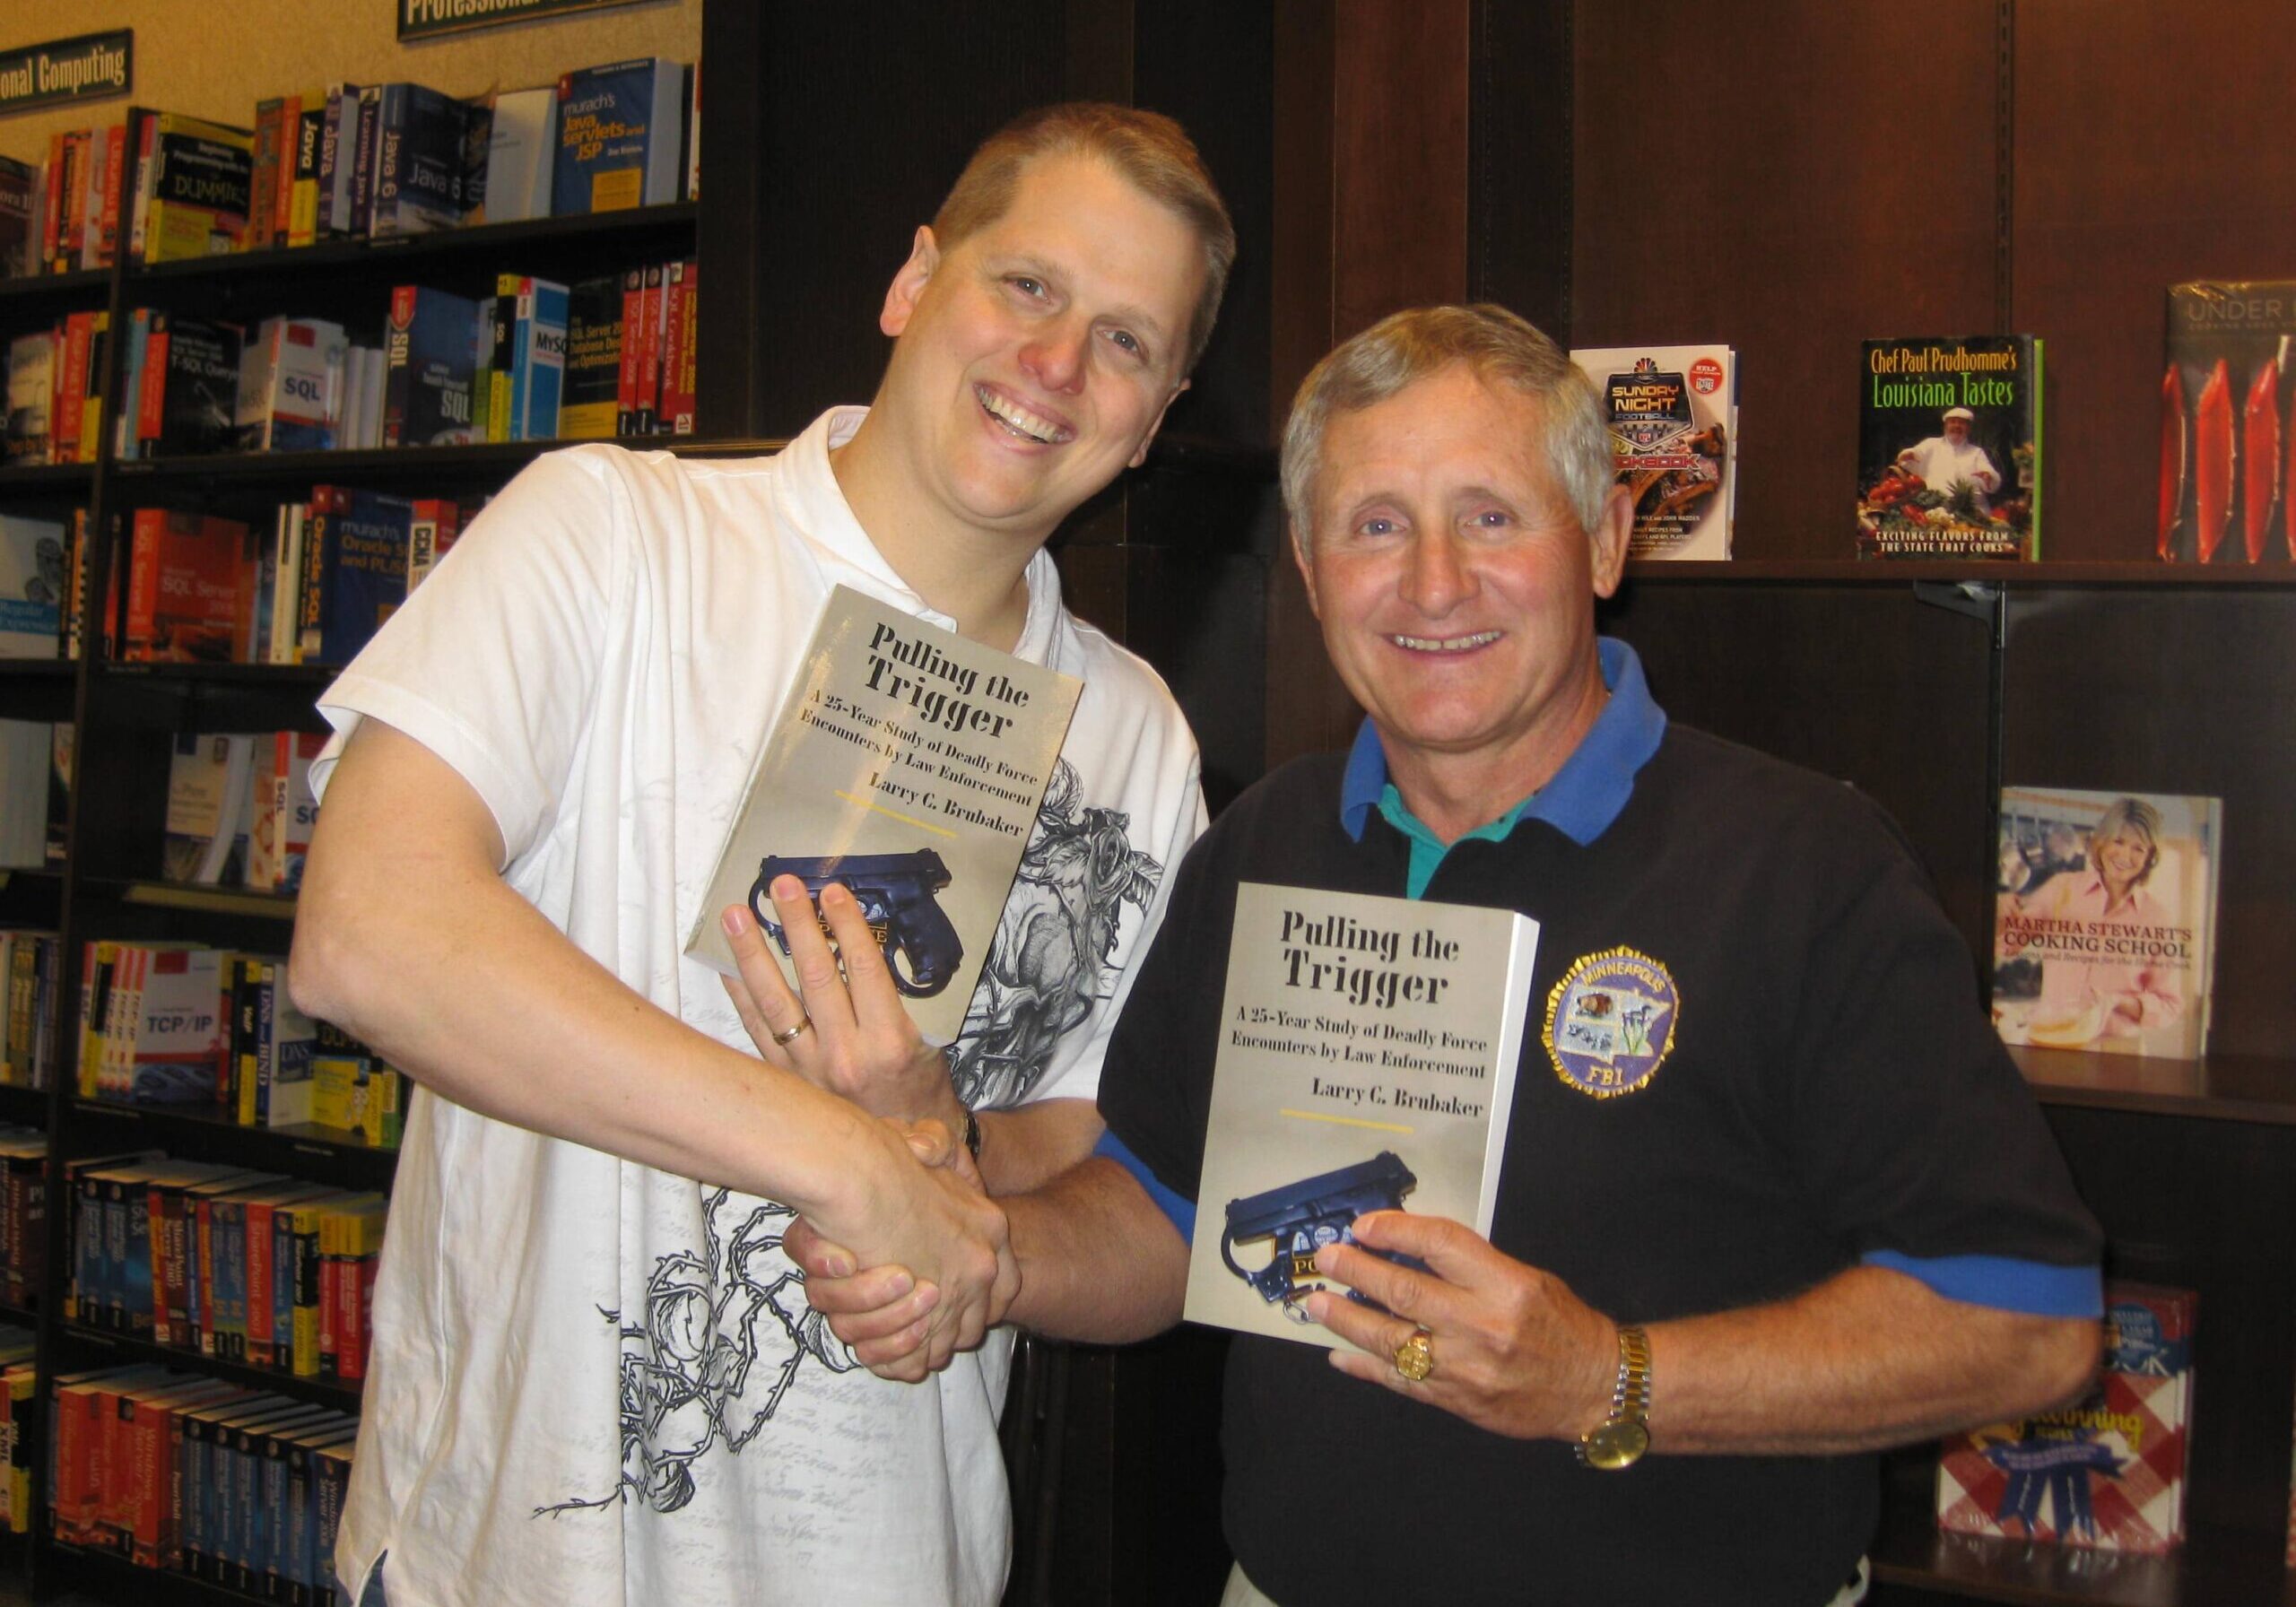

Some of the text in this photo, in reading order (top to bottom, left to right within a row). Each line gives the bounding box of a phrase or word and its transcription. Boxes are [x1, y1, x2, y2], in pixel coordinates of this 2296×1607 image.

[39, 47, 126, 93] Computing
[563, 92, 617, 115] murach's
[357, 109, 374, 176] Learning
[566, 115, 597, 133] Java
[301, 119, 317, 169] Java
[320, 126, 339, 178] Java
[576, 141, 604, 162] JSP
[381, 132, 401, 198] Java 6
[408, 162, 462, 200] Java 6
[2188, 299, 2283, 321] UNDER
[390, 333, 409, 369] SQL
[536, 332, 570, 357] MySQ
[665, 288, 678, 389] SQL Cookbook
[171, 353, 202, 374] T-SQL
[1871, 345, 2017, 373] Chef Paul Prudhomme's
[284, 377, 320, 401] SQL
[440, 389, 470, 423] SQL
[1612, 386, 1680, 397] SUNDAY
[1615, 397, 1676, 412] NIGHT
[1874, 371, 2013, 408] Louisiana Tastes
[1613, 413, 1675, 421] FOOTBALL
[1614, 454, 1700, 470] OKBOOK
[309, 516, 326, 583] Oracle
[340, 535, 392, 558] Oracle
[413, 527, 432, 567] CCNA
[1876, 531, 2008, 542] EXCITING FLAVORS FROM
[1881, 542, 2003, 552] THE STATE THAT COOKS
[370, 556, 407, 577] PL/S
[162, 577, 238, 599] SQL Server
[307, 587, 321, 626] SQL
[868, 622, 1031, 708] Pulling the
[865, 654, 1015, 739] Trigger
[810, 689, 1039, 786] A 25-Year Study of Deadly Force
[800, 708, 1033, 807] Encounters by Law Enforcement
[275, 782, 286, 814] SQL
[868, 771, 1024, 838] Larry C. Brubaker
[1280, 910, 1460, 964] Pulling the
[2004, 916, 2192, 942] MARTHA STEWART'S
[2004, 931, 2191, 959] COOKING SCHOOL
[1283, 948, 1449, 1010] Trigger
[1580, 961, 1666, 994] MINNEAPOLIS
[147, 1014, 213, 1034] TCP/IP
[261, 989, 273, 1024] DNS
[1237, 1005, 1488, 1053] A 25-Year Study of Deadly Force
[258, 1043, 270, 1086] BIND
[1231, 1029, 1485, 1080] Encounters by Law Enforcement
[1586, 1065, 1624, 1086] FBI
[1312, 1077, 1484, 1118] Larry C. Brubaker
[250, 1223, 264, 1334] SharePoint 2007
[144, 1428, 157, 1501] Windows
[171, 1471, 182, 1519] PowerShell
[318, 1478, 329, 1517] Server
[329, 1481, 338, 1540] Windows
